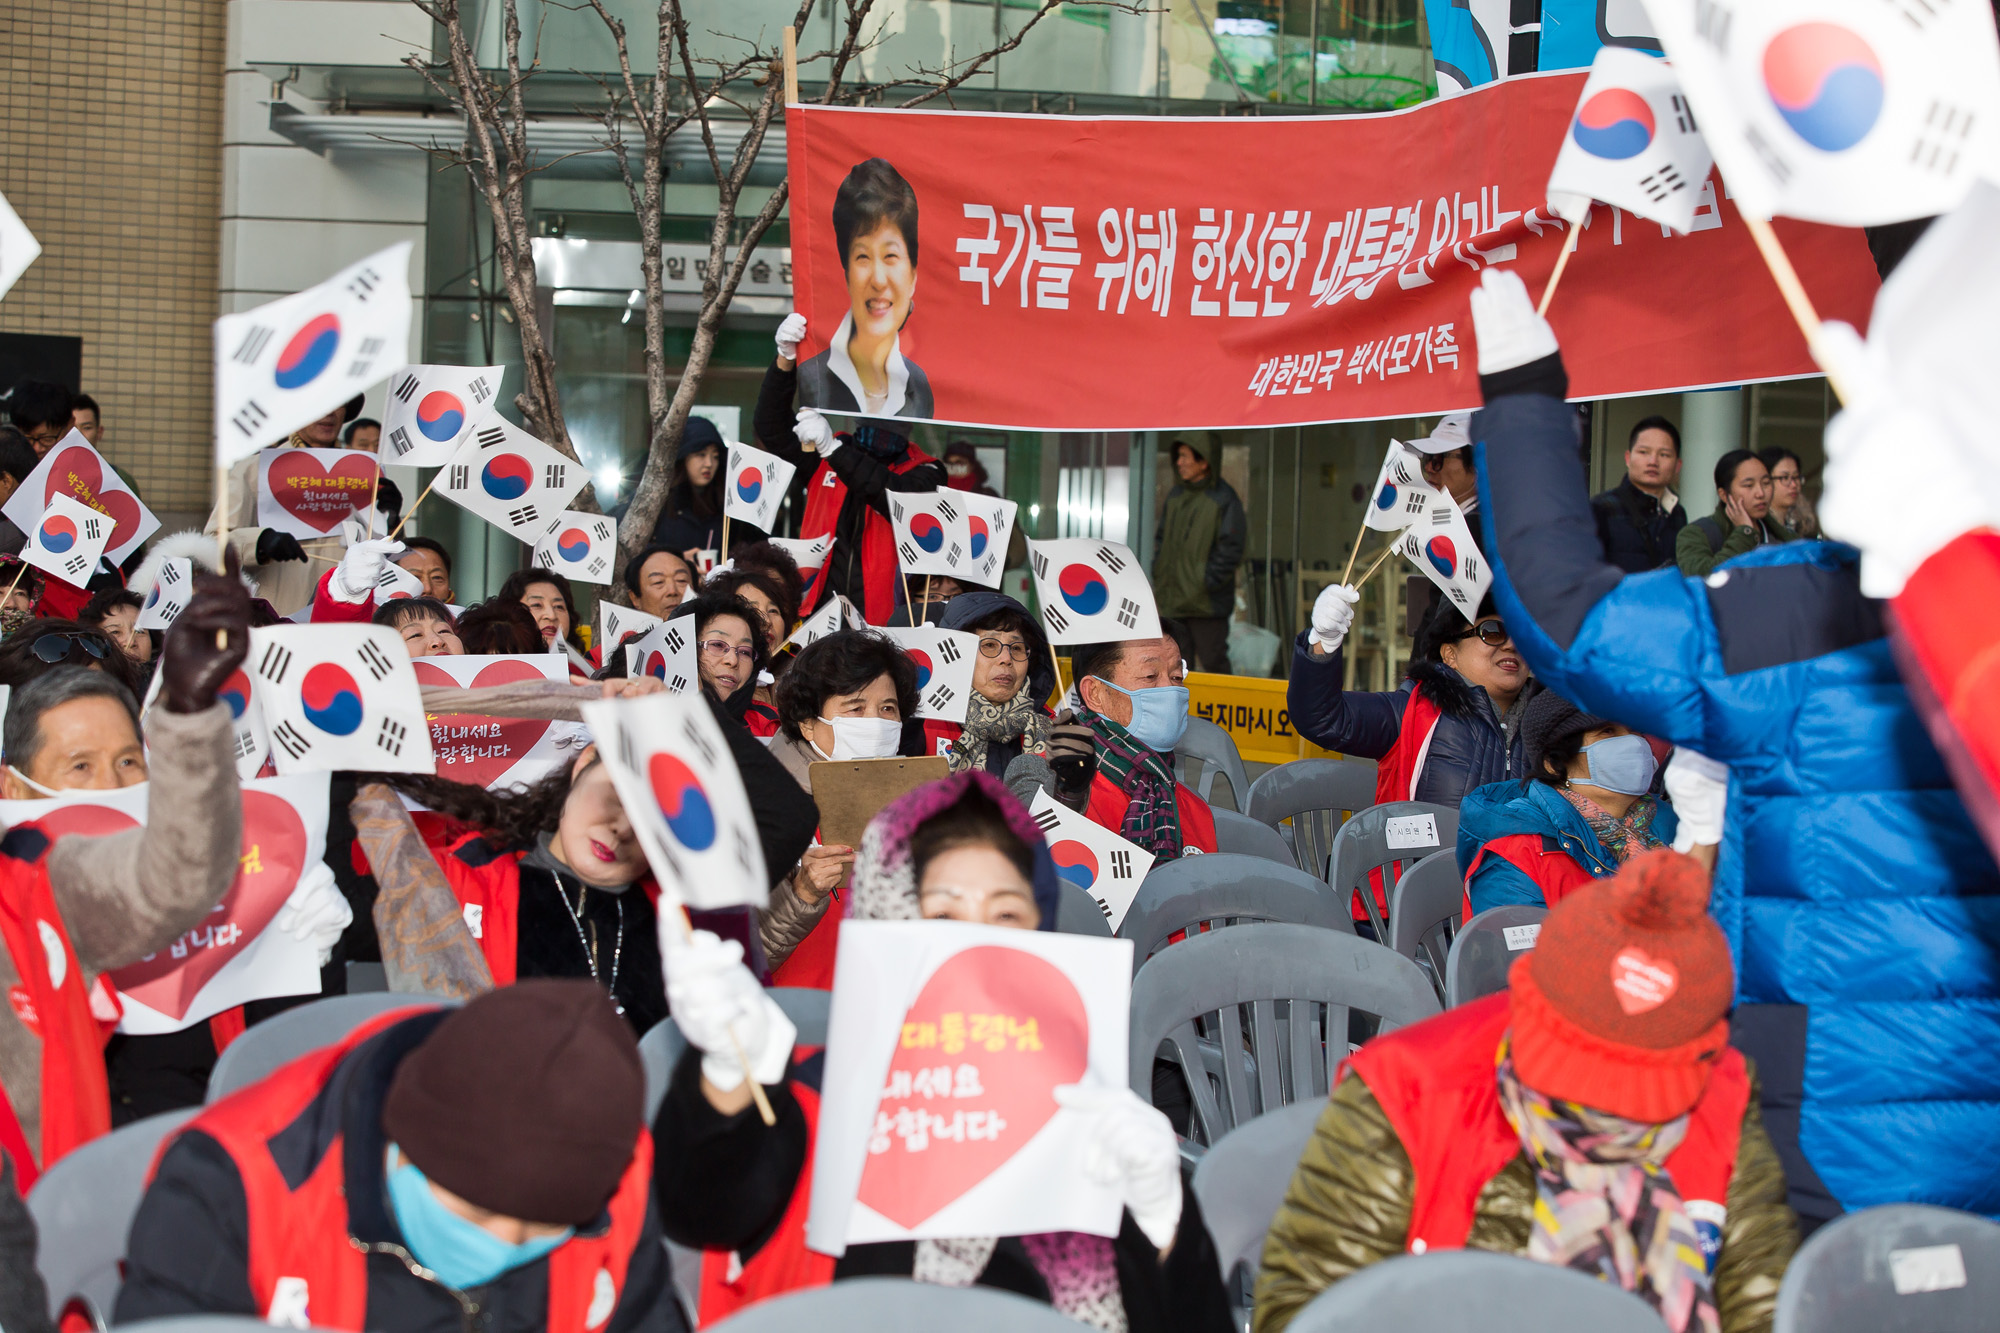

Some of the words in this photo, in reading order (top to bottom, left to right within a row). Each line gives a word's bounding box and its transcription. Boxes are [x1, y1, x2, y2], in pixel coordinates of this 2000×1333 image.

[955, 203, 1082, 310] 국가를
[1094, 206, 1177, 317] 위해
[1190, 207, 1310, 317] 헌신한
[1309, 199, 1423, 308] 대통령
[1248, 349, 1344, 397] 대한민국
[1347, 322, 1460, 385] 박사모가족
[68, 471, 92, 501] 박근혜
[286, 476, 322, 489] 박근혜
[324, 476, 370, 490] 대통령님
[303, 489, 350, 502] 힘내세요
[295, 502, 355, 512] 사랑합니다
[431, 722, 503, 744] 힘내세요
[901, 1012, 1044, 1054] 대통령님
